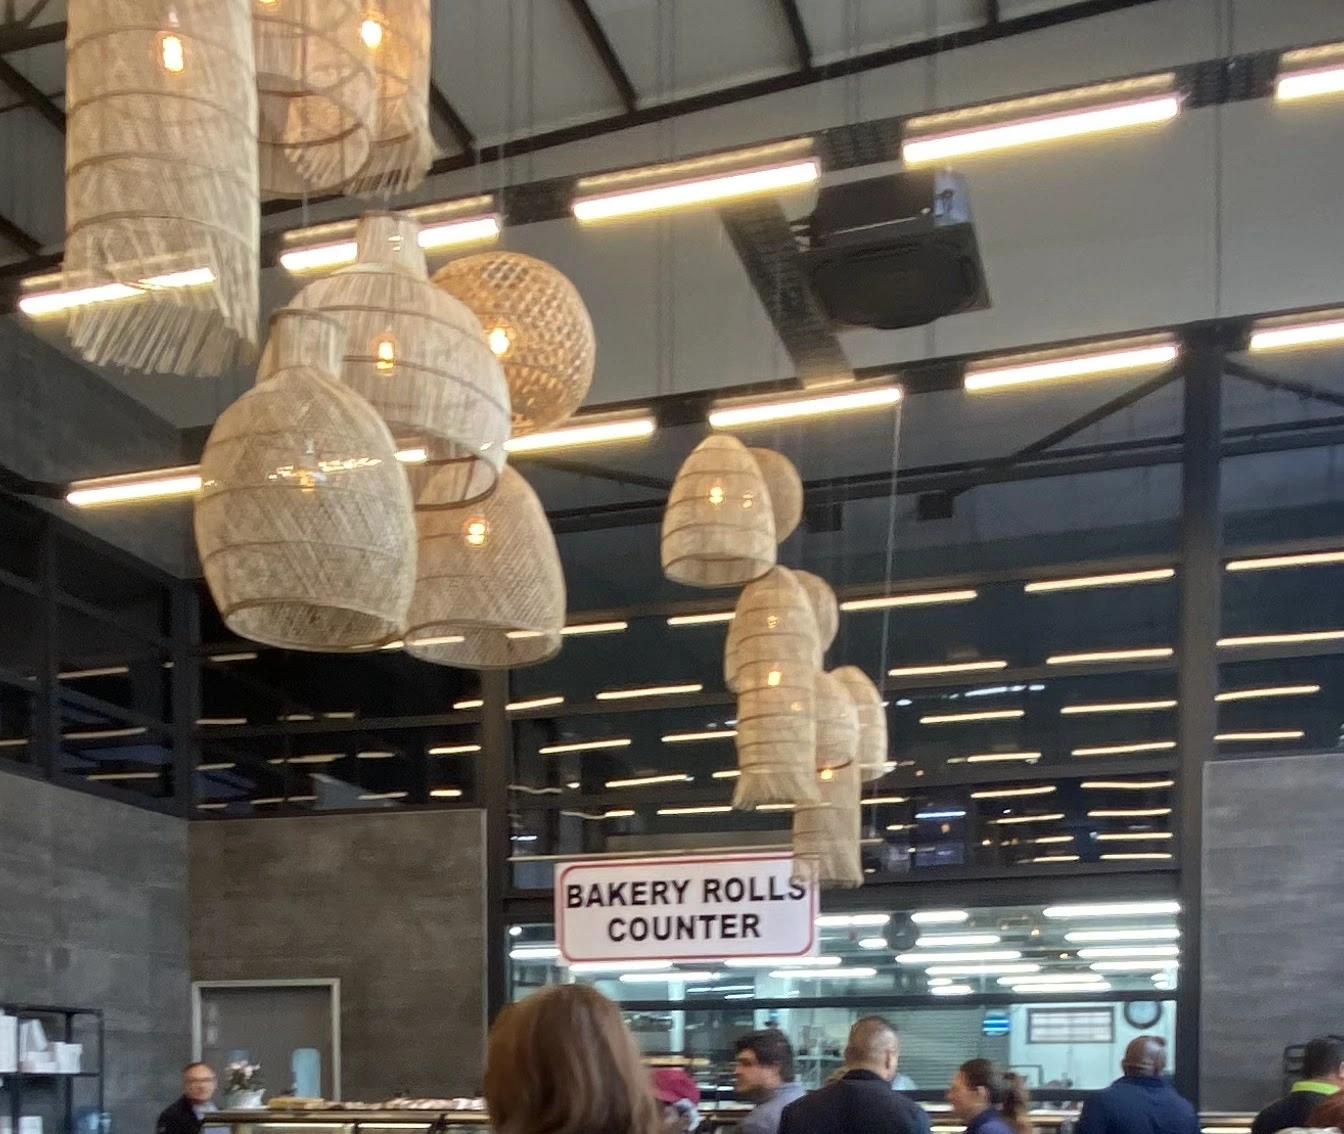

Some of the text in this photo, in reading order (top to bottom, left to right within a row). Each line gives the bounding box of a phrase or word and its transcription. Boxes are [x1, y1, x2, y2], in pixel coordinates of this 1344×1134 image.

[566, 875, 807, 909] BAKERY ROLLS
[607, 912, 761, 942] COUNTER
